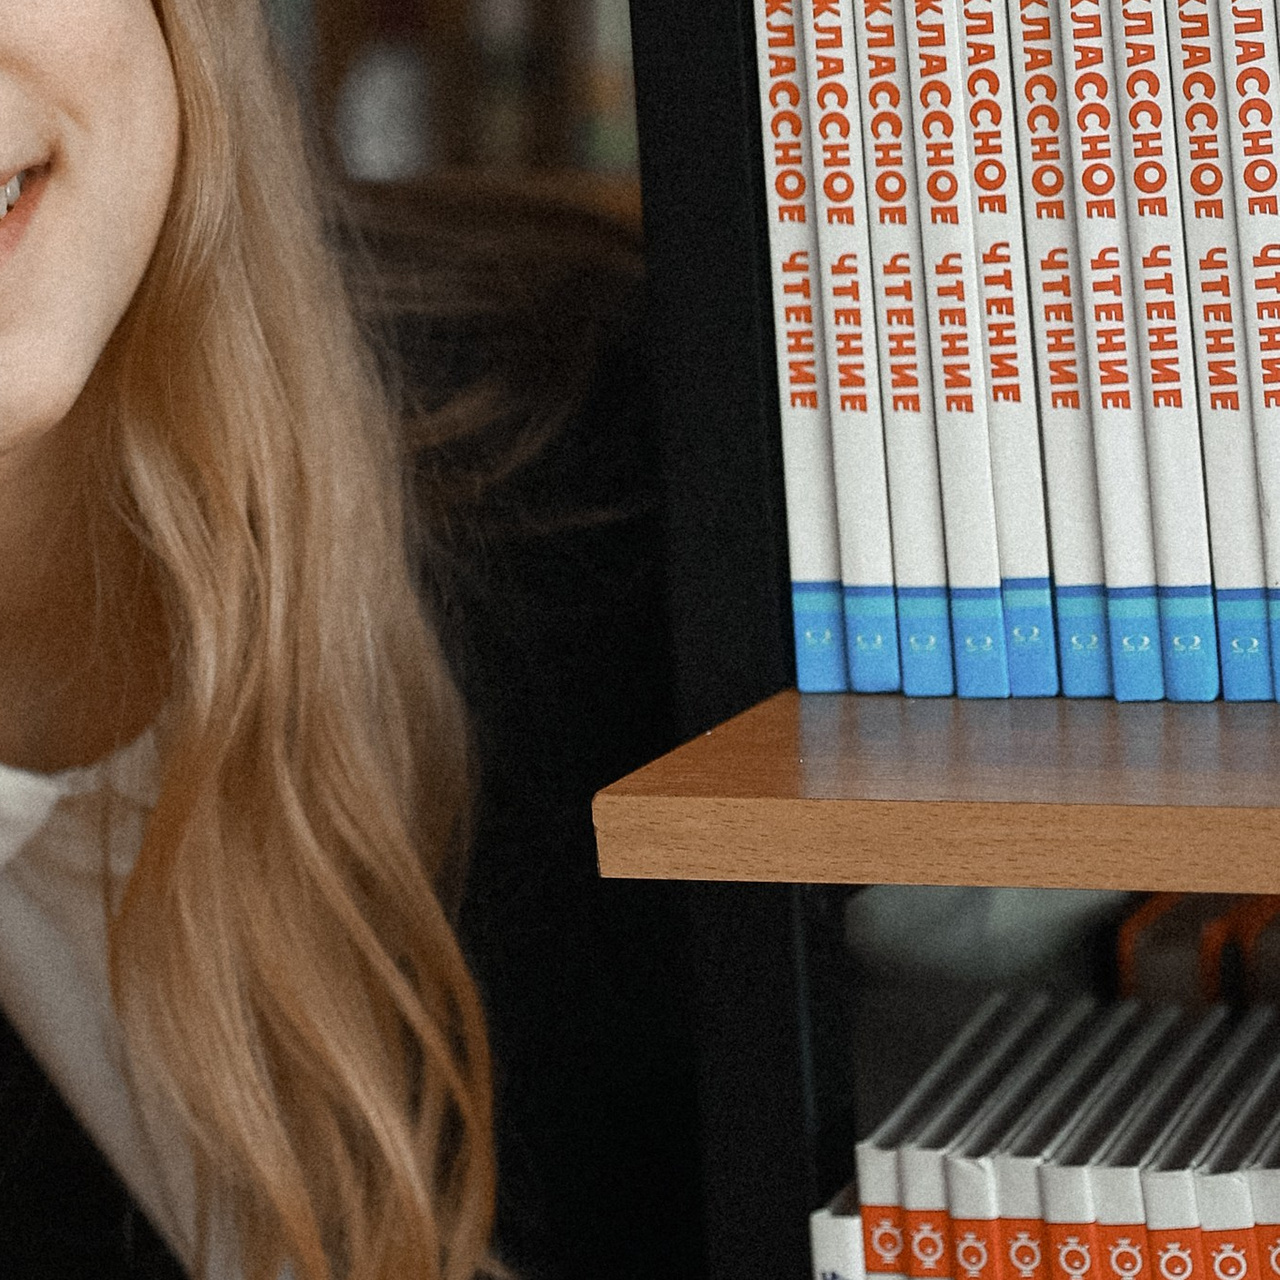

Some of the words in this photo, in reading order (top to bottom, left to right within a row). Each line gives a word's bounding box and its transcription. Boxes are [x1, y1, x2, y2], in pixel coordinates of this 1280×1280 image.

[783, 252, 818, 409] ЧТЕНИЕ
[831, 254, 868, 413] ЧТЕНИЕ
[883, 254, 921, 413] ЧТЕНИЕ
[936, 253, 974, 414] ЧТЕНИЕ
[983, 242, 1021, 403] ЧТЕНИЕ
[1041, 250, 1080, 409] ЧТЕНИЕ
[1091, 247, 1132, 410] ЧТЕНИЕ
[1143, 245, 1183, 409] ЧТЕНИЕ
[1200, 248, 1240, 411] ЧТЕНИЕ
